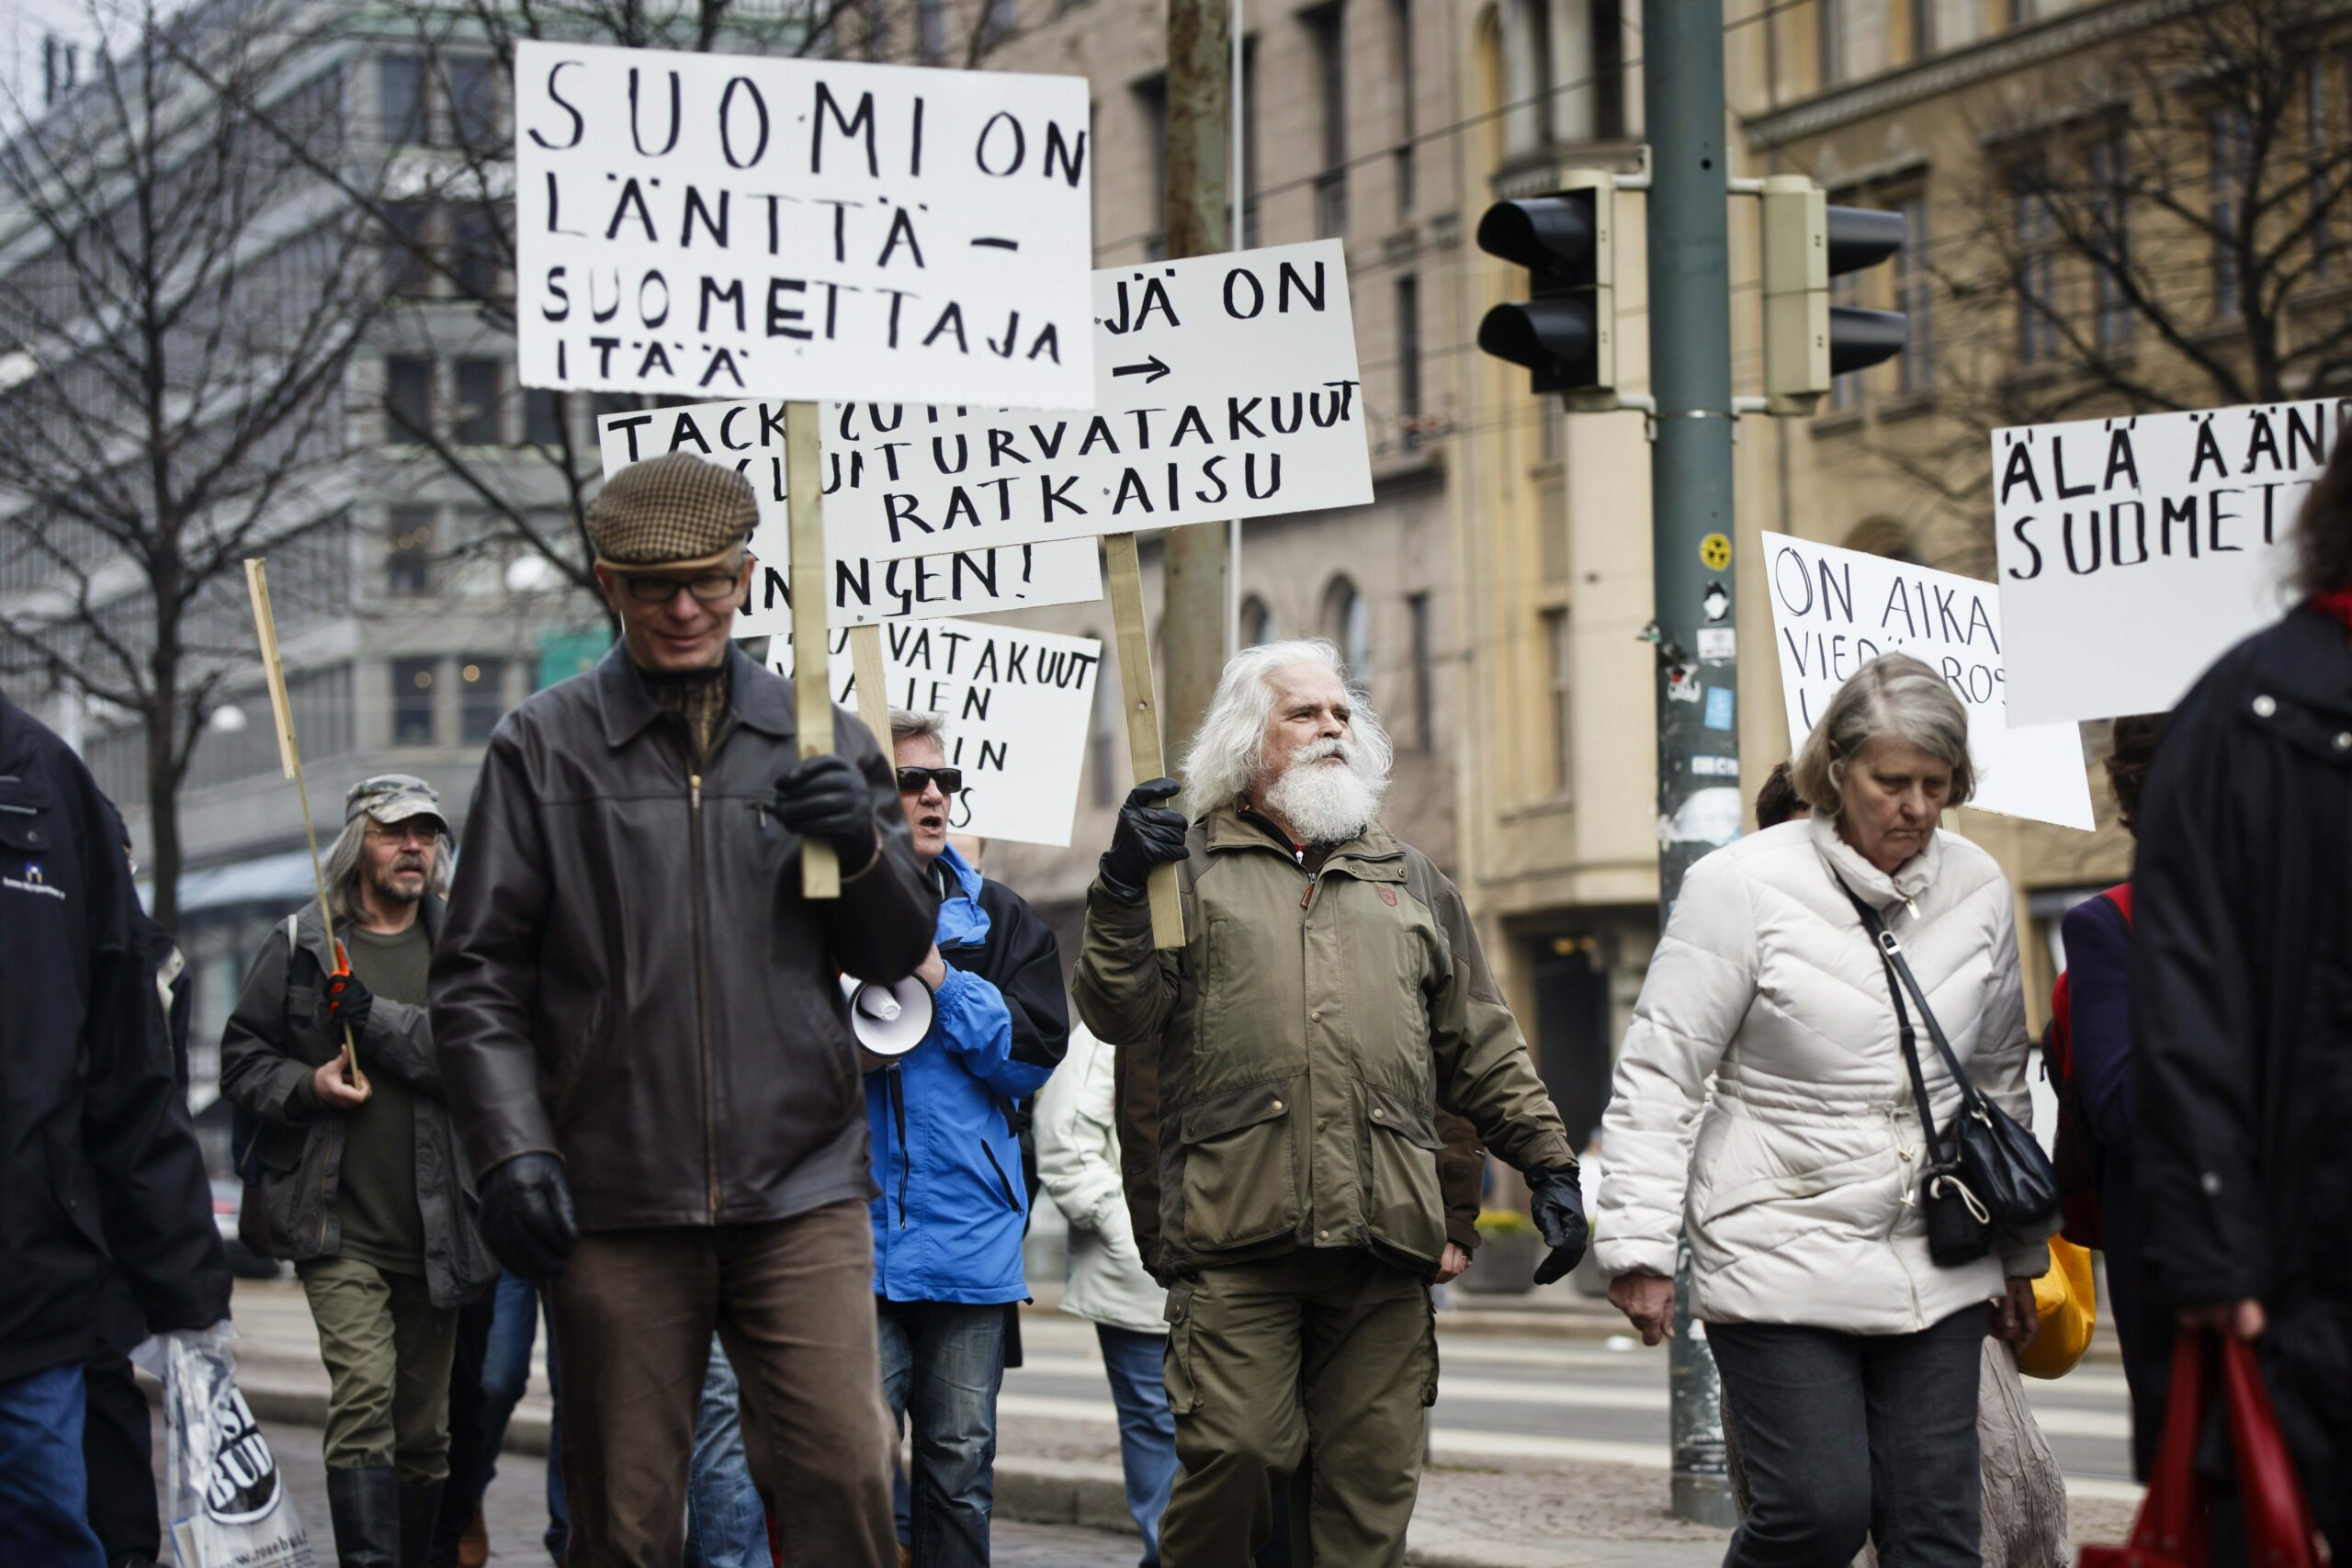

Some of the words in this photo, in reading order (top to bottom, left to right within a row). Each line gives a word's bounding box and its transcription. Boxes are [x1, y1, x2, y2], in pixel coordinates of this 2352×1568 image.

[527, 61, 923, 177] SUOMI
[976, 111, 1085, 187] ON
[547, 172, 928, 268] LÄNTTÄ
[541, 265, 1061, 366] SUOMETTAJA
[1103, 267, 1181, 334] JÄ
[1223, 260, 1325, 320] ON
[557, 336, 750, 389] ITÄÄ
[607, 403, 787, 462] TACK
[875, 380, 1360, 481] TURVATAKUUT
[2002, 416, 2140, 505] ÄLÄ
[2189, 400, 2345, 482] ÄÄN
[883, 453, 1281, 543] RATKAISU
[2007, 479, 2315, 581] SUOMET
[1776, 547, 1854, 625] ON
[1881, 576, 2000, 655] AIKA
[1941, 656, 2007, 705] ROS
